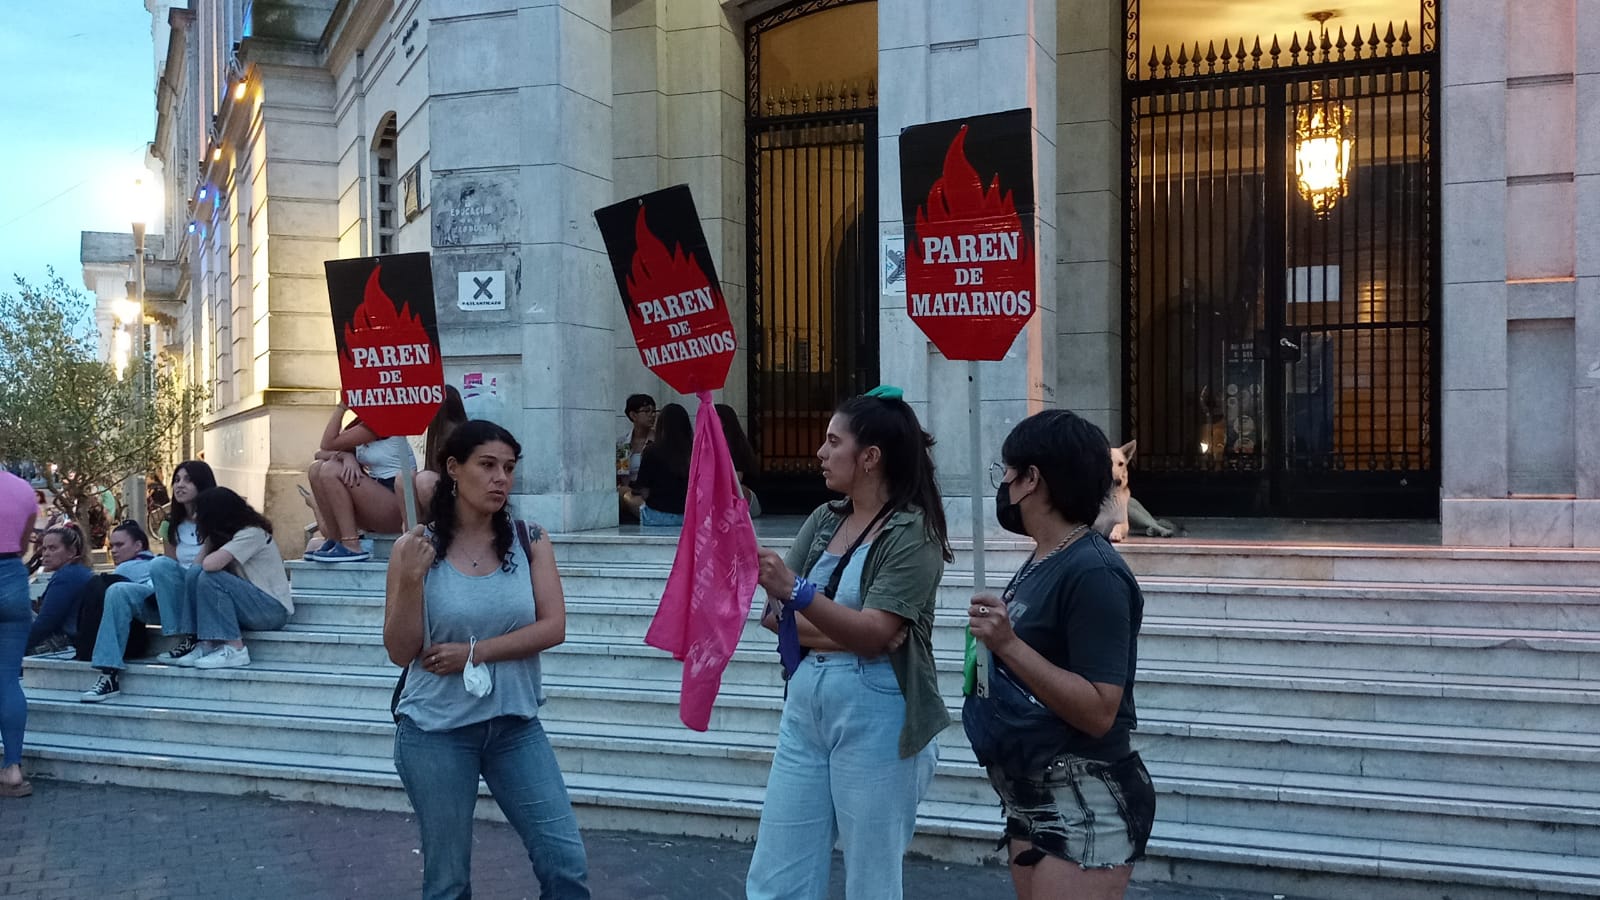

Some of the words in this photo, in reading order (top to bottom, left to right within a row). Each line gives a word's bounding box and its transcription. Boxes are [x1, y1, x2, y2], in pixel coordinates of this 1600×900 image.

[922, 231, 1020, 265] PAREN
[954, 267, 984, 286] DE
[637, 286, 714, 325] PAREN
[911, 290, 1031, 317] MATARNOS
[667, 320, 692, 338] DE
[351, 343, 430, 369] PAREN
[642, 330, 736, 368] MATARNOS
[378, 370, 403, 385] DE
[346, 385, 443, 407] MATARNOS
